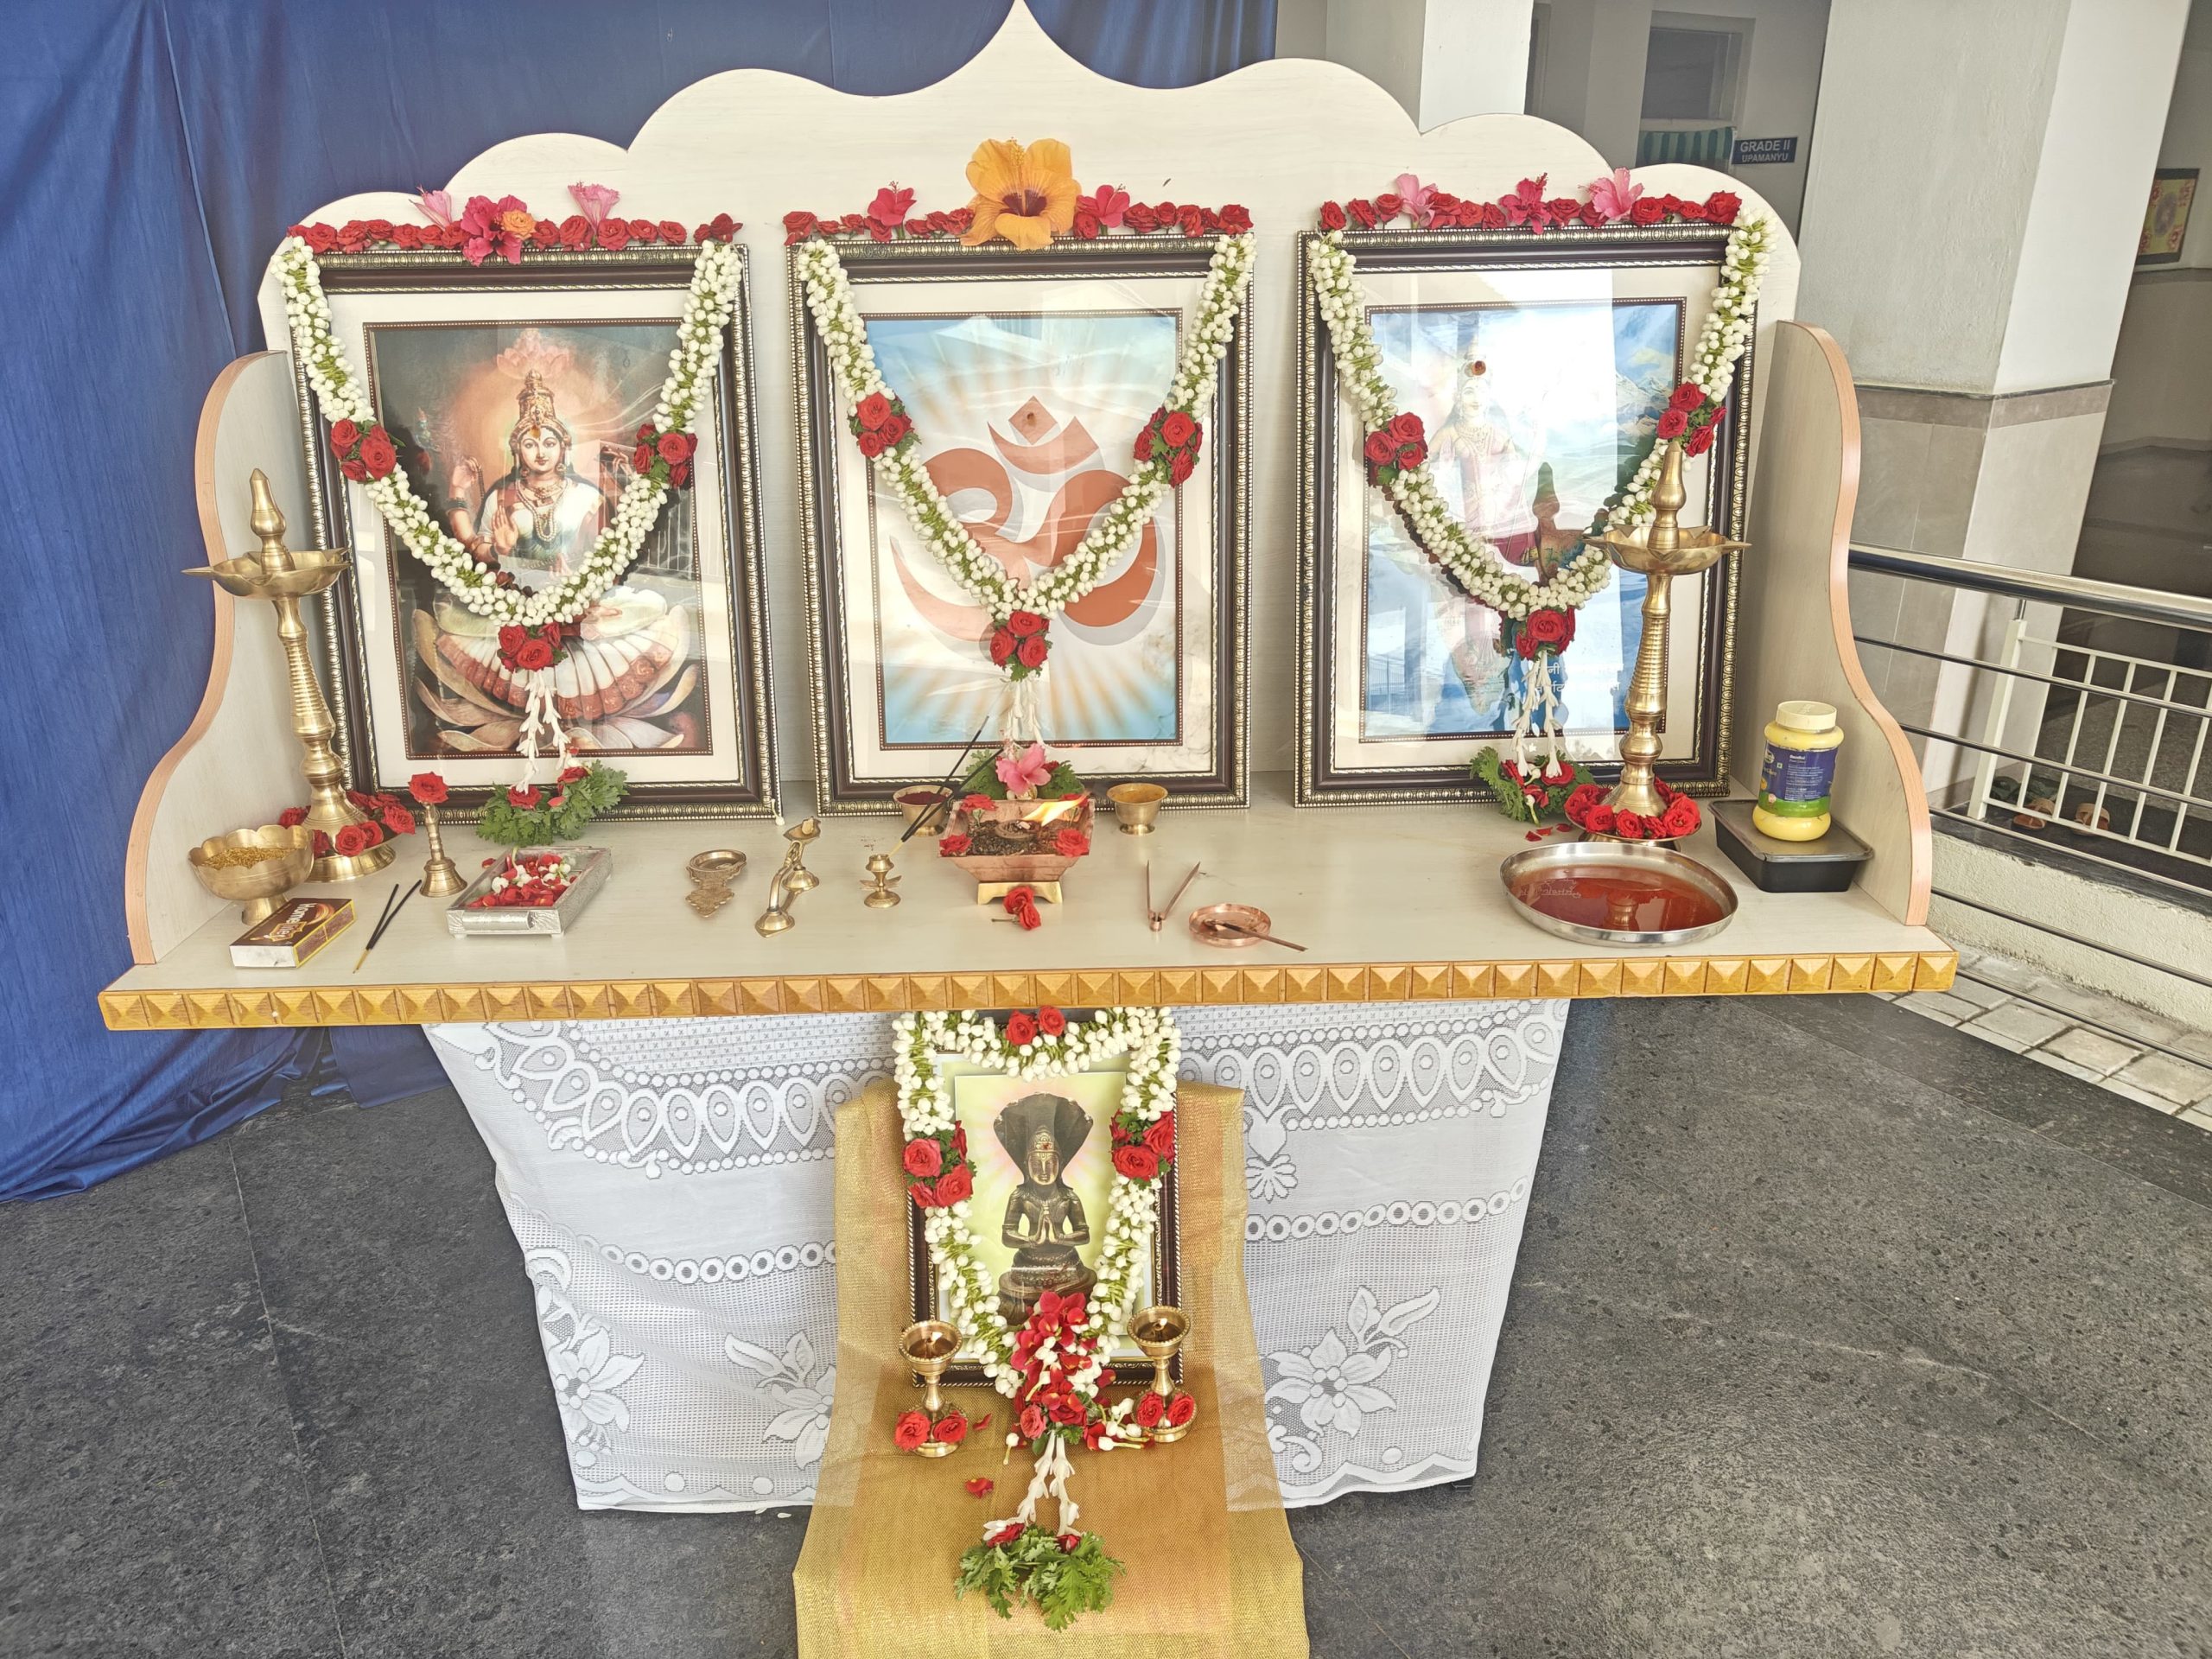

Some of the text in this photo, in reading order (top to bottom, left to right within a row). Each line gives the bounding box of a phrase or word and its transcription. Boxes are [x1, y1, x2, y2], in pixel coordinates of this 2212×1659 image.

[1740, 139, 1790, 152] GRADE II
[1742, 153, 1789, 162] UPAMANYU
